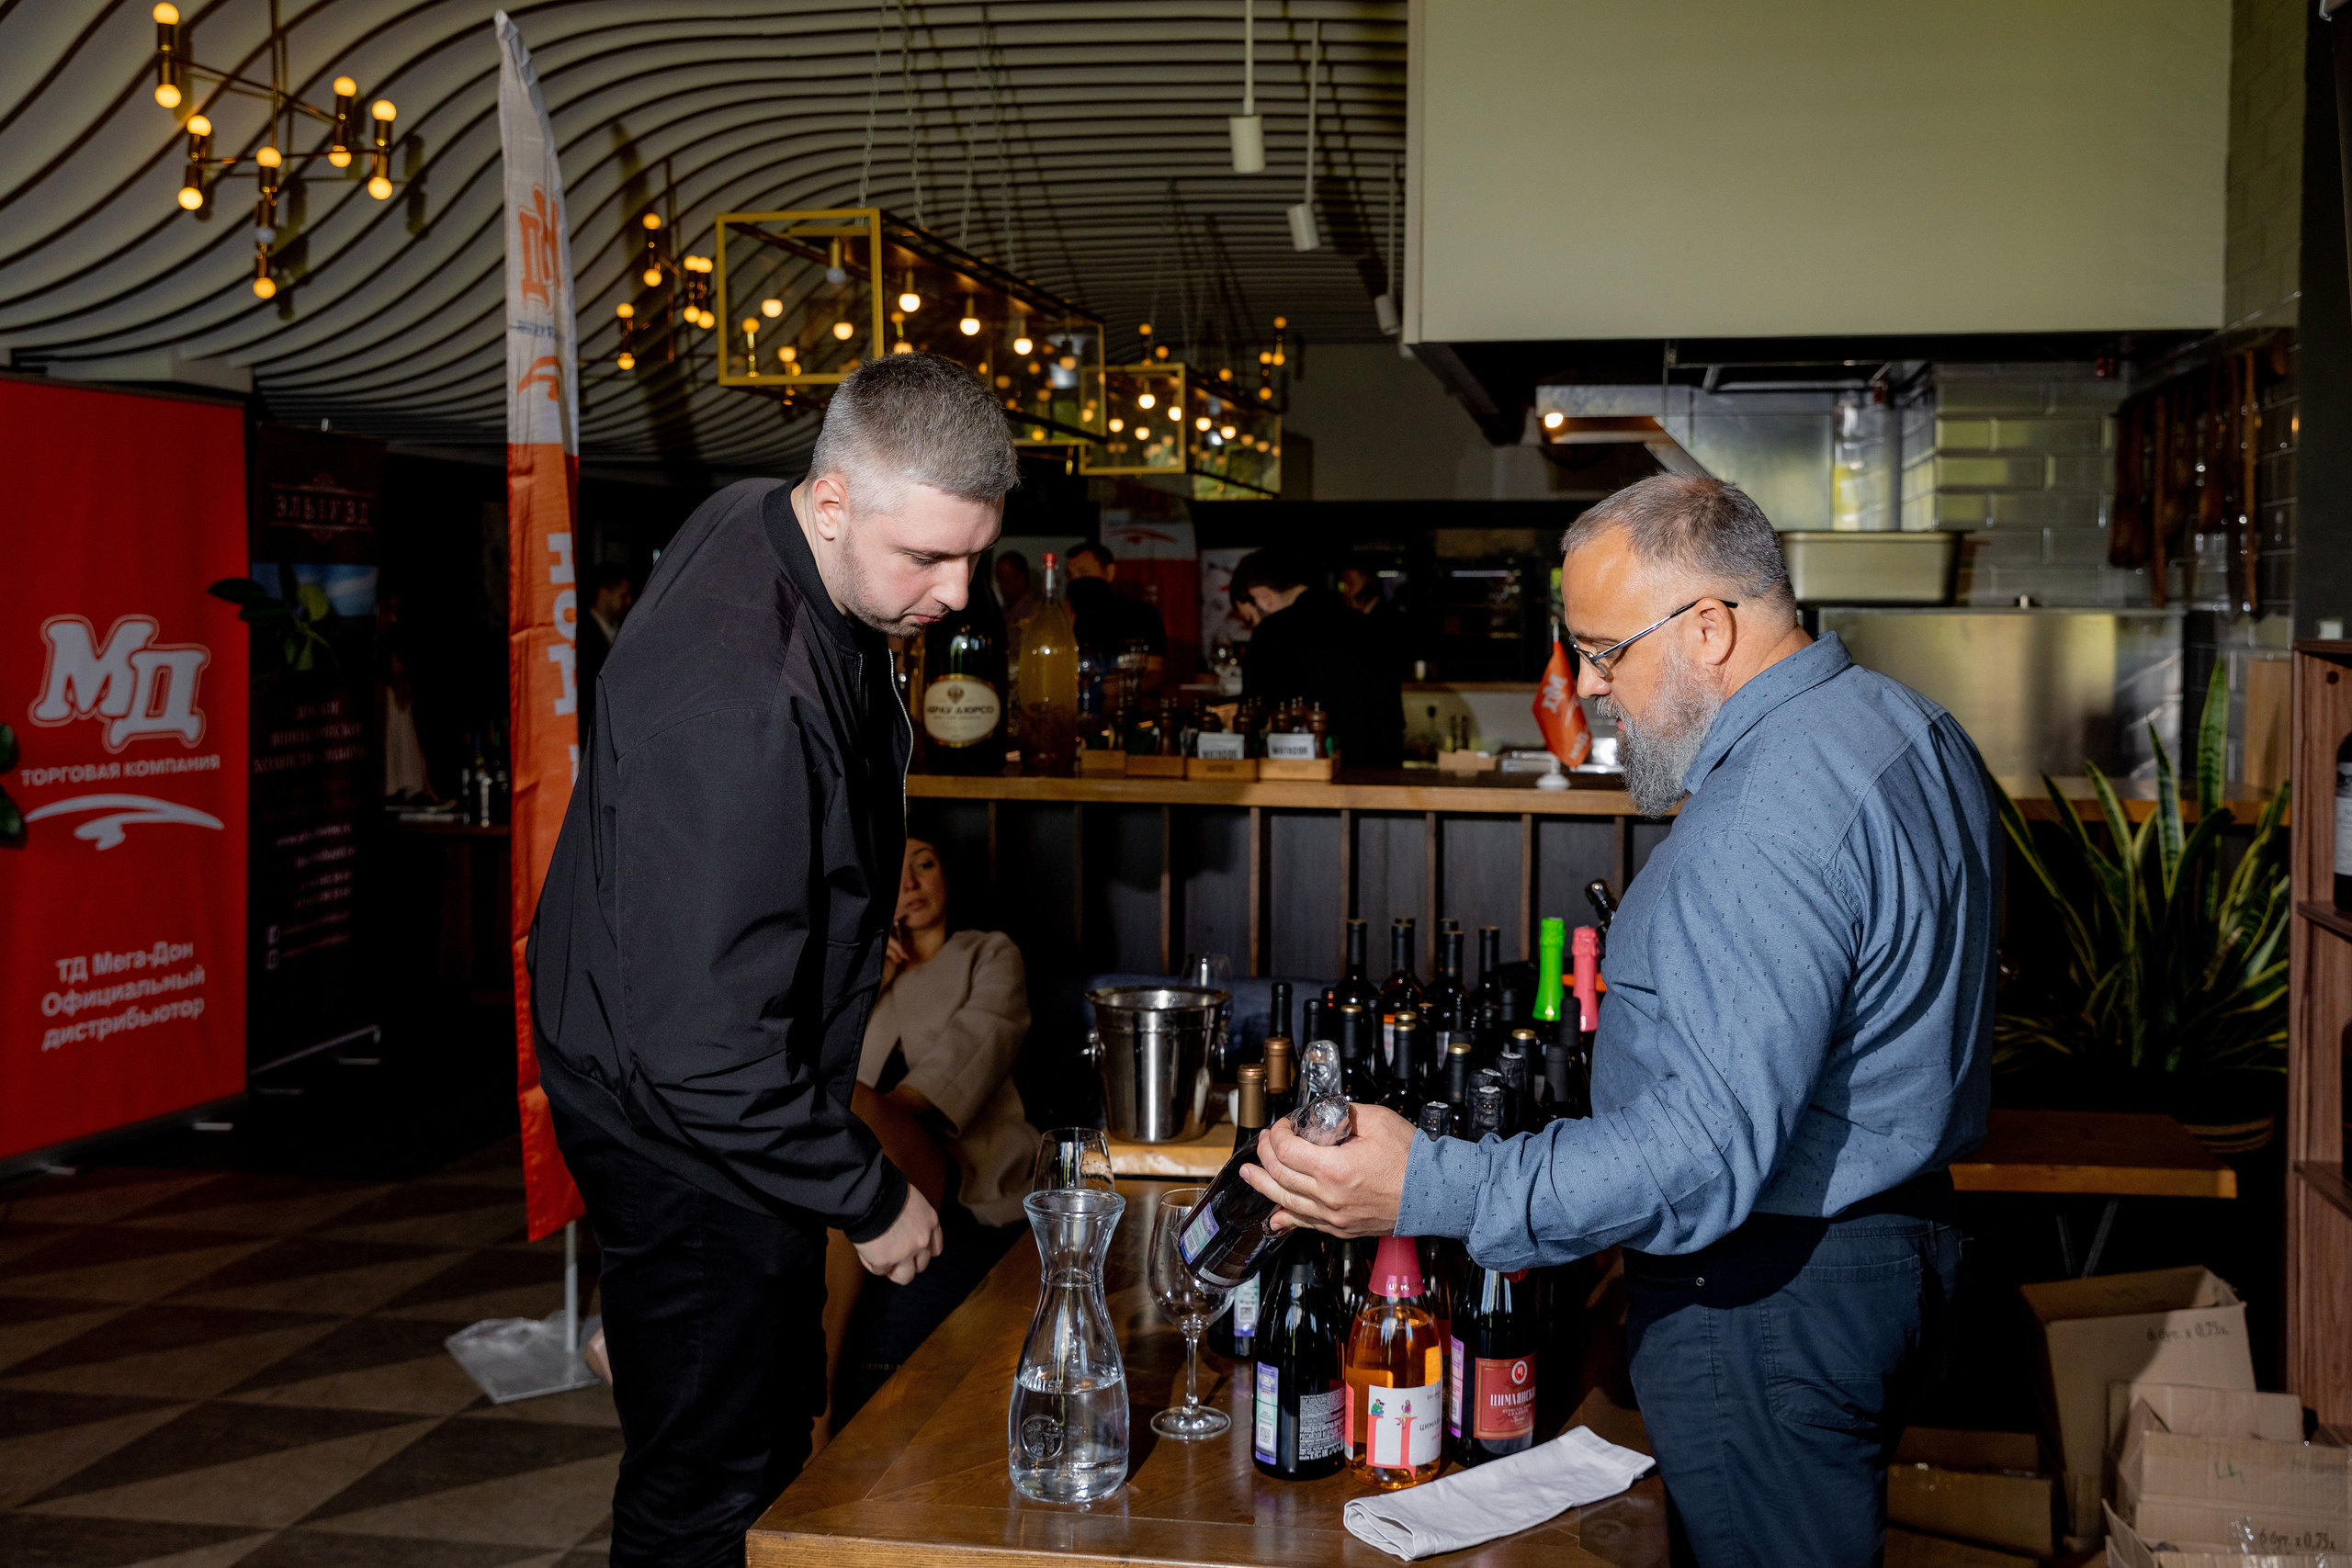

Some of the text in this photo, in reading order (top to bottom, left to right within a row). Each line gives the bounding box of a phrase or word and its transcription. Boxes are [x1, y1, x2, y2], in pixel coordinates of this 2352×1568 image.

[28, 615, 210, 753] МД
[20, 753, 220, 787] ТОРГОВАЯ КОМПАНИЯ
[54, 941, 194, 986] ТД Мега-Дон
[40, 963, 206, 1018] Официальный
[40, 997, 206, 1053] дистрибьютор
[2146, 1325, 2155, 1341] 6
[2259, 1529, 2267, 1544] 6
